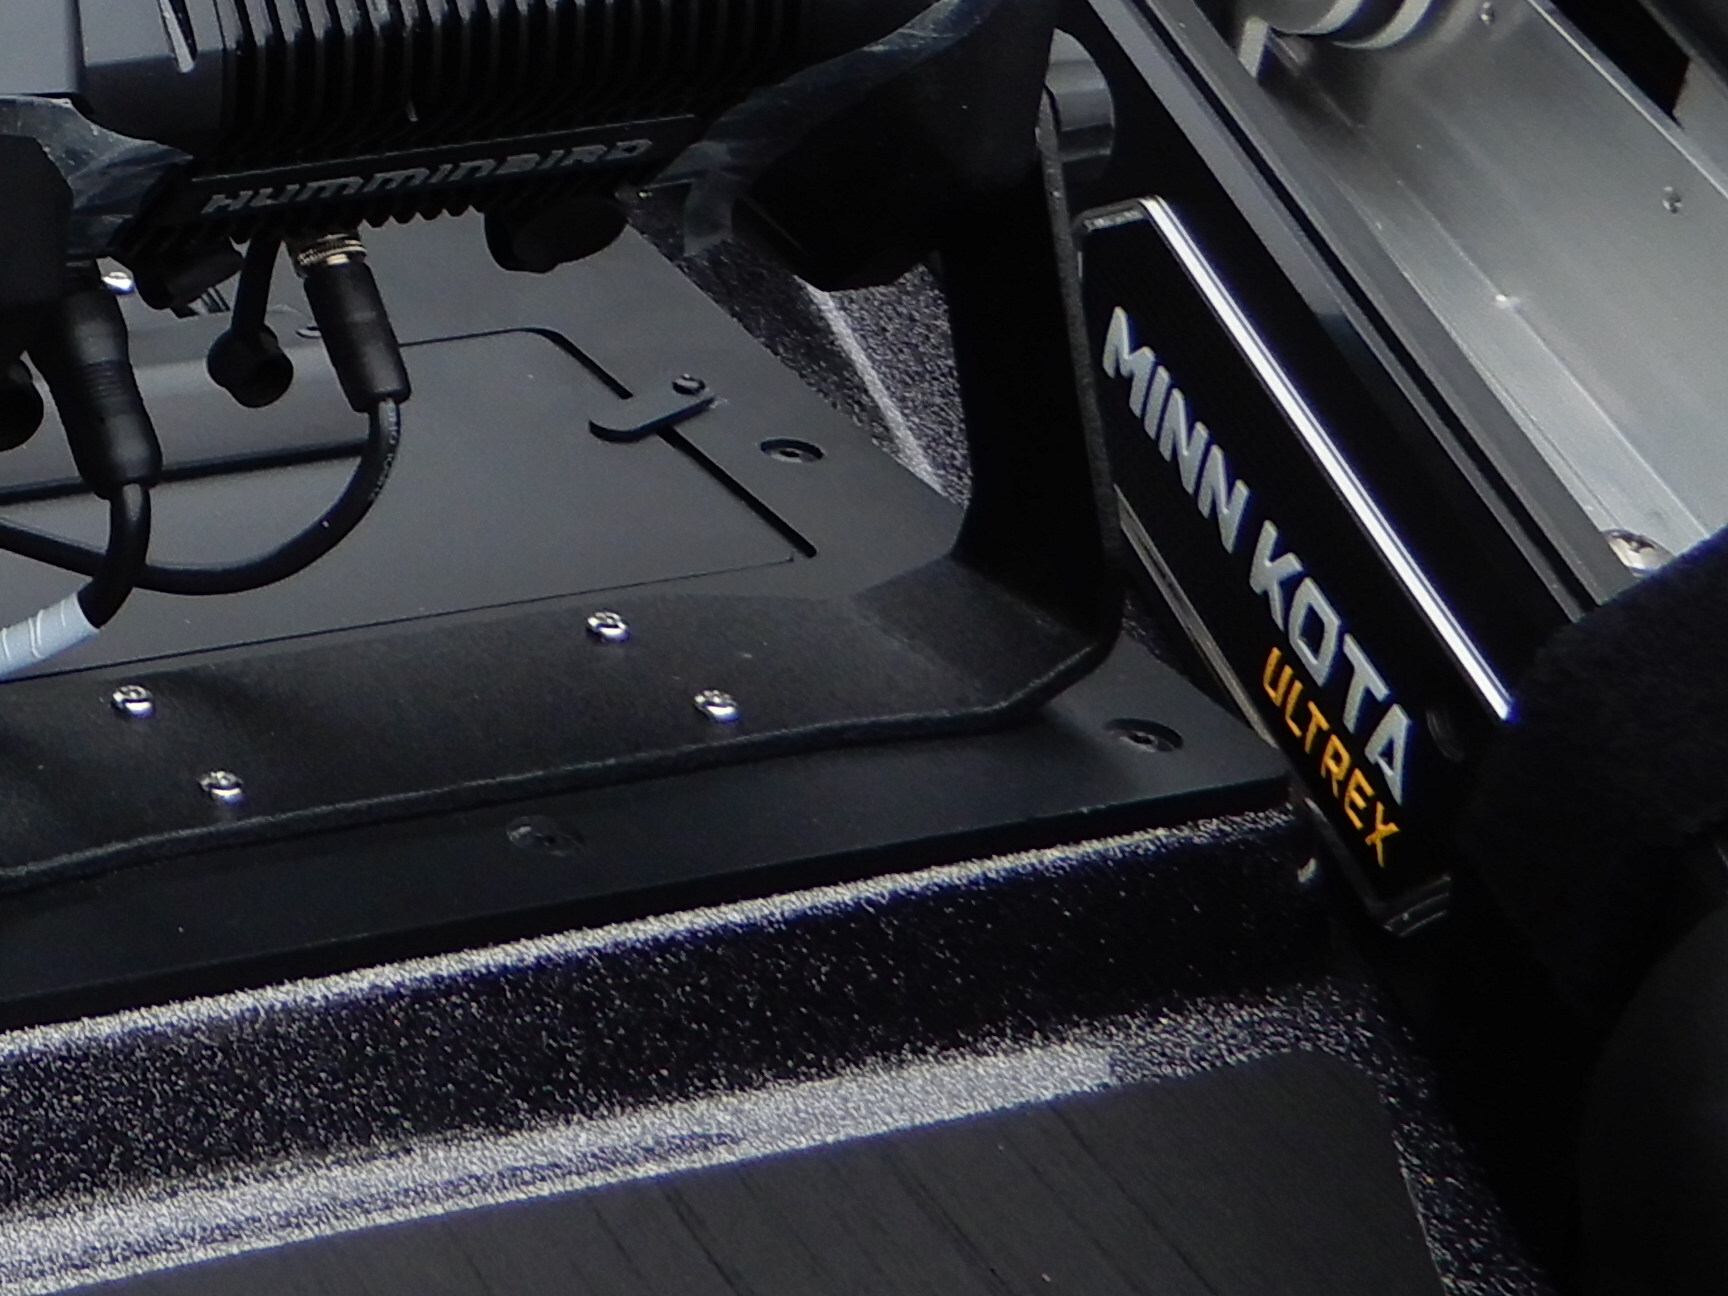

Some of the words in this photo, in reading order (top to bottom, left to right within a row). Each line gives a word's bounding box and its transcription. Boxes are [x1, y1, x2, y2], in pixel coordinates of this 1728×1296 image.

[201, 139, 653, 214] HUMMINBIRD
[1101, 305, 1252, 555] MINN
[1248, 518, 1412, 806] KOTA
[1262, 646, 1401, 869] ULTREX
